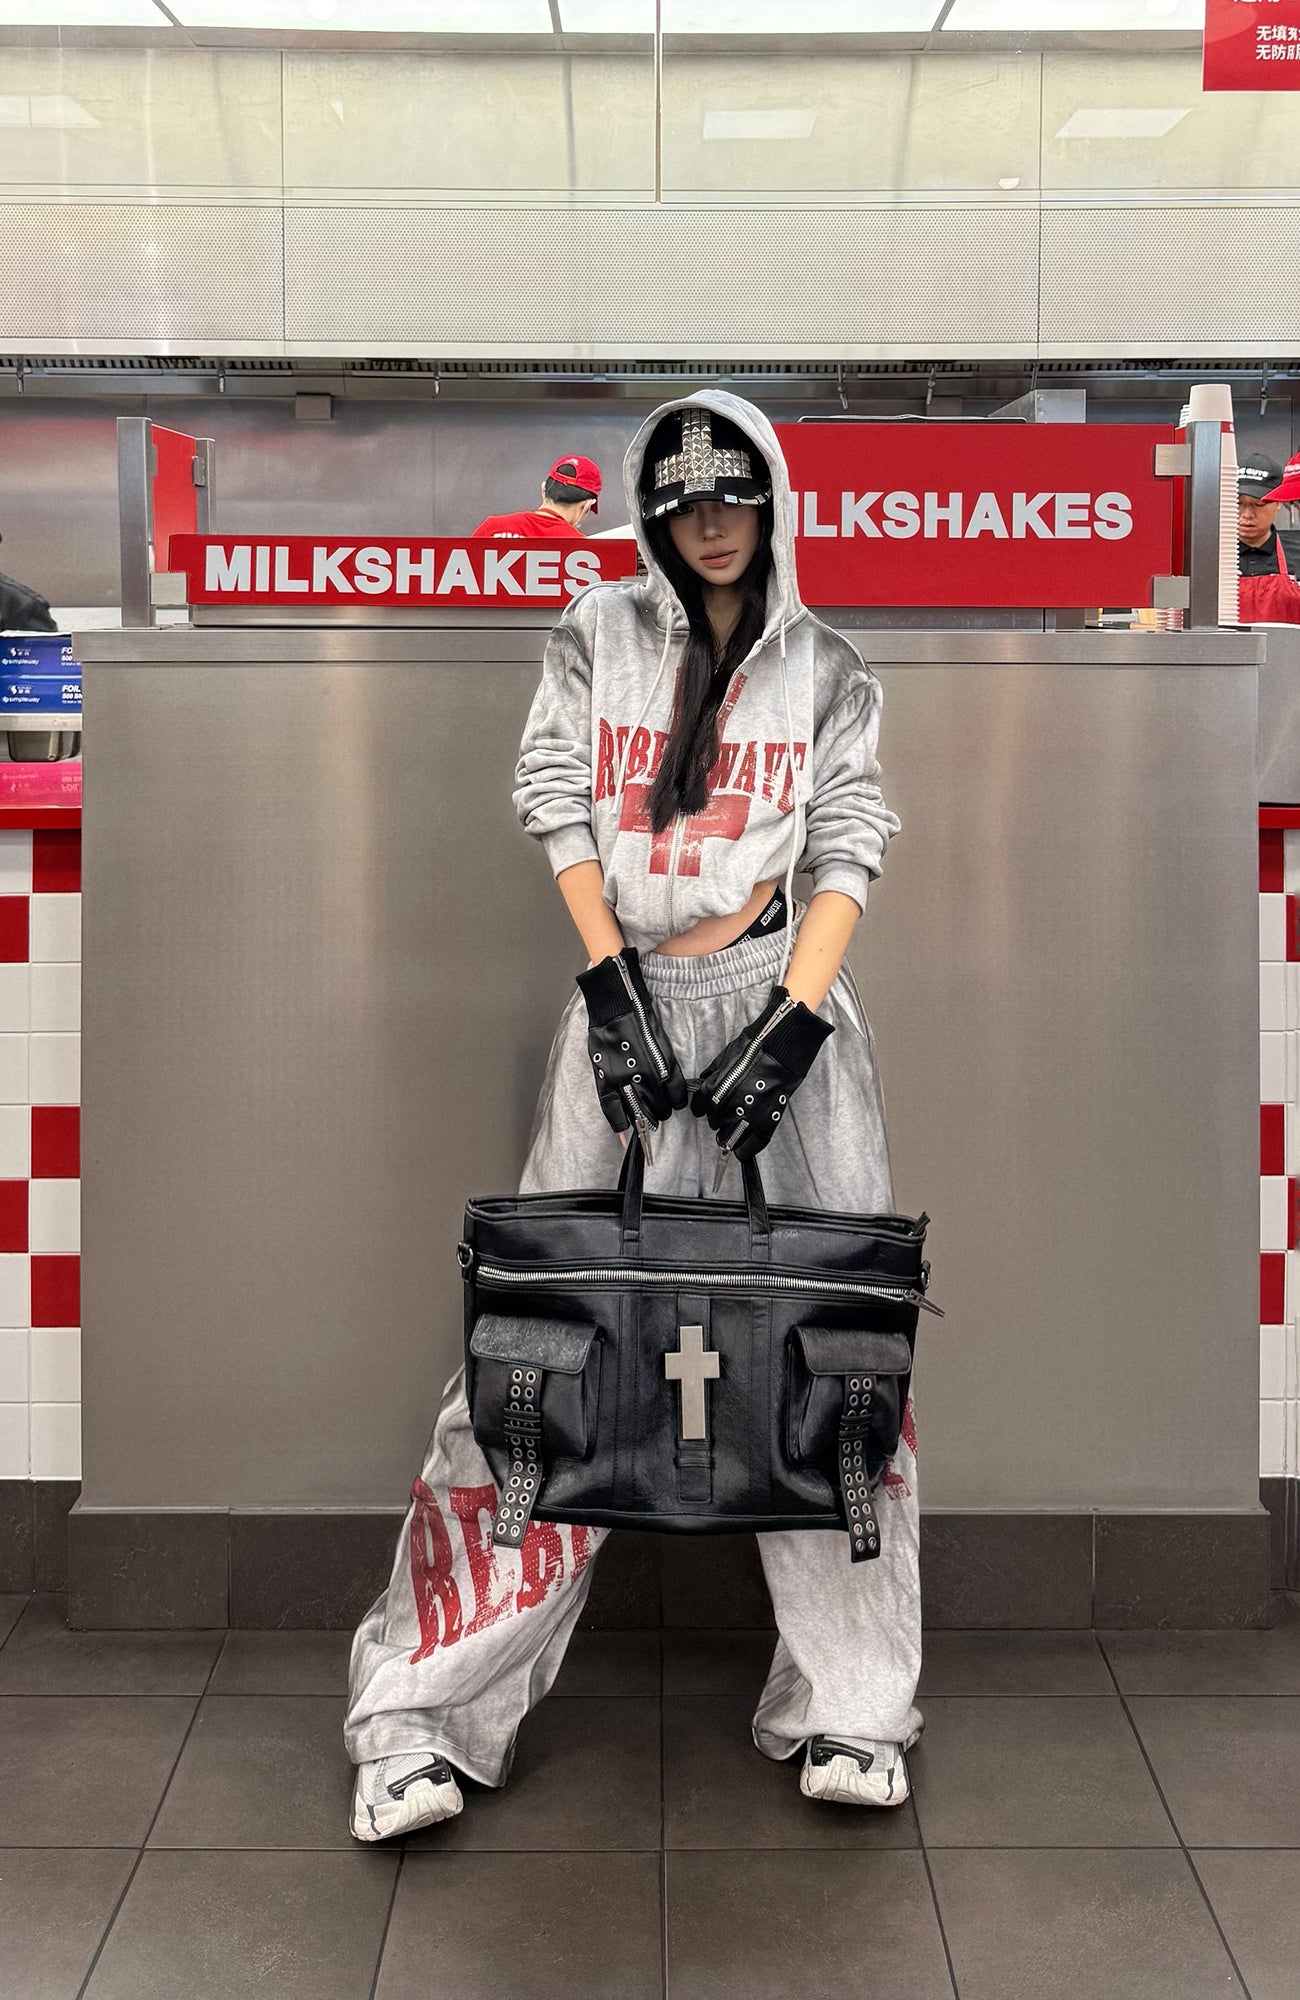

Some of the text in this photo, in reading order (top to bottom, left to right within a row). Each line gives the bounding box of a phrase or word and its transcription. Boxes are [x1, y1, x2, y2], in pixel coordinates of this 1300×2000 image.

[789, 491, 1133, 539] LKSHAKES
[205, 545, 602, 597] MILKSHAKES
[62, 684, 81, 692] FOIL
[595, 717, 672, 803] REBE
[408, 1476, 600, 1664] REB
